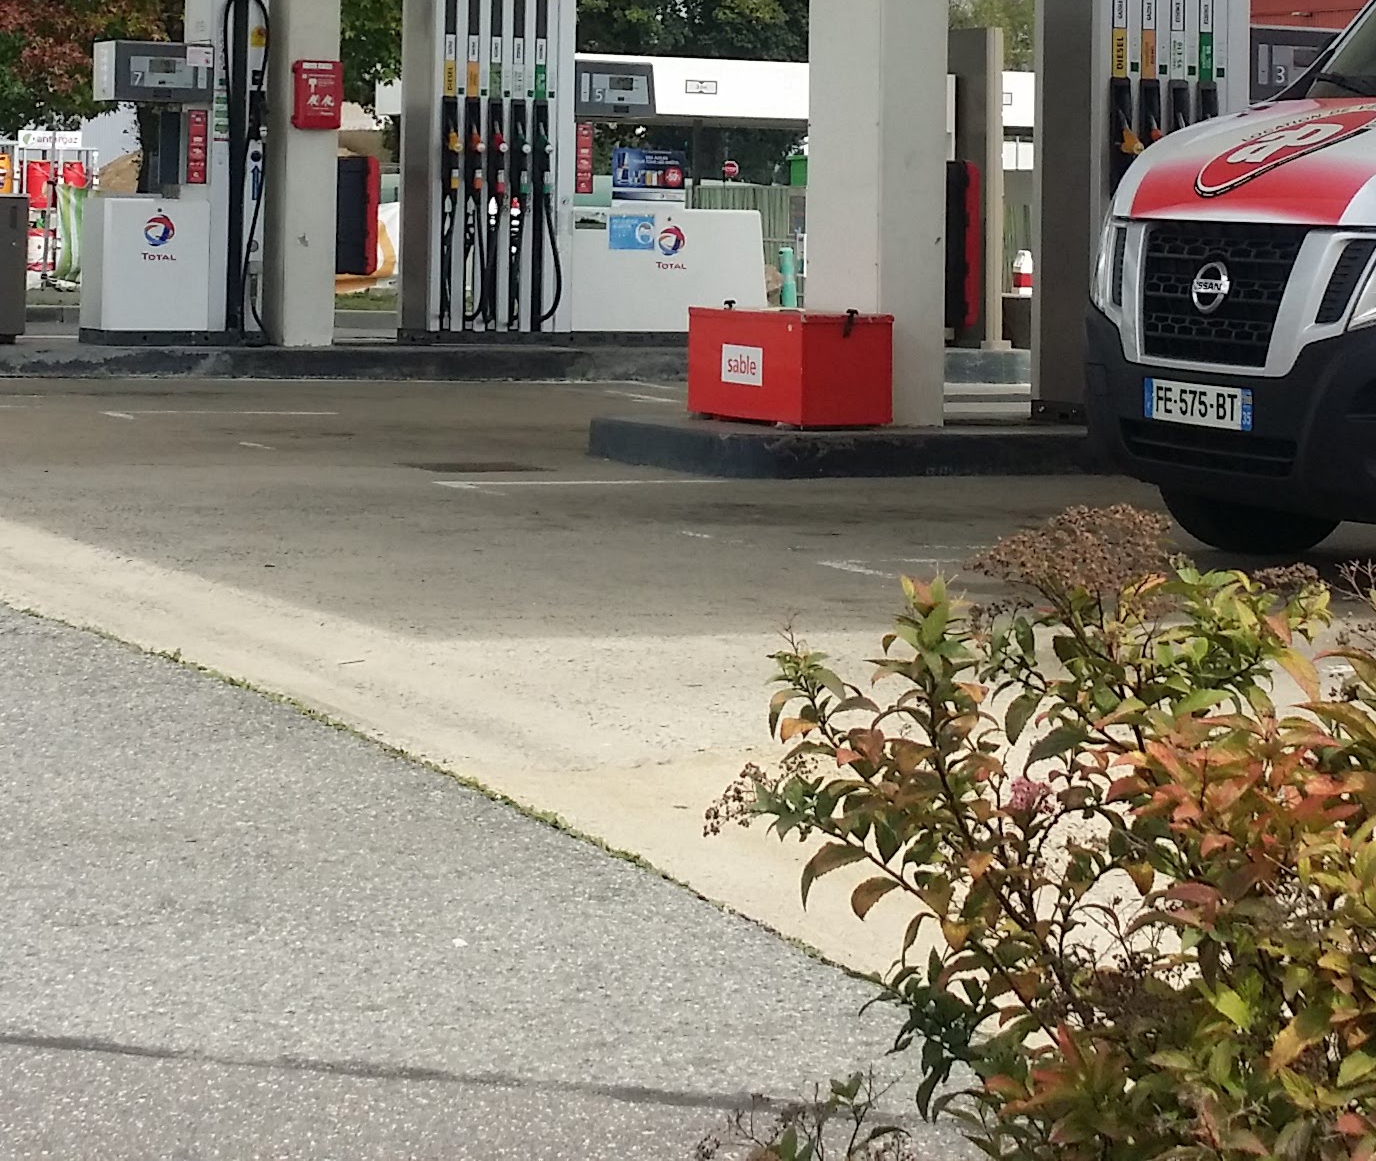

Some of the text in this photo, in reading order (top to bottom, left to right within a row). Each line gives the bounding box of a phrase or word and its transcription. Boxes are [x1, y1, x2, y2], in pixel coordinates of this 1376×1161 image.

[1116, 36, 1124, 70] DIESEL
[133, 71, 143, 86] 7
[1275, 65, 1286, 84] 3
[595, 89, 603, 102] 5
[36, 134, 78, 145] antrgaz
[140, 252, 177, 262] TOTAL
[655, 261, 687, 270] TOTAL
[1194, 281, 1223, 291] SSAN
[727, 353, 757, 376] sable
[1155, 385, 1238, 422] FE-575-BT
[1241, 411, 1252, 426] 35
